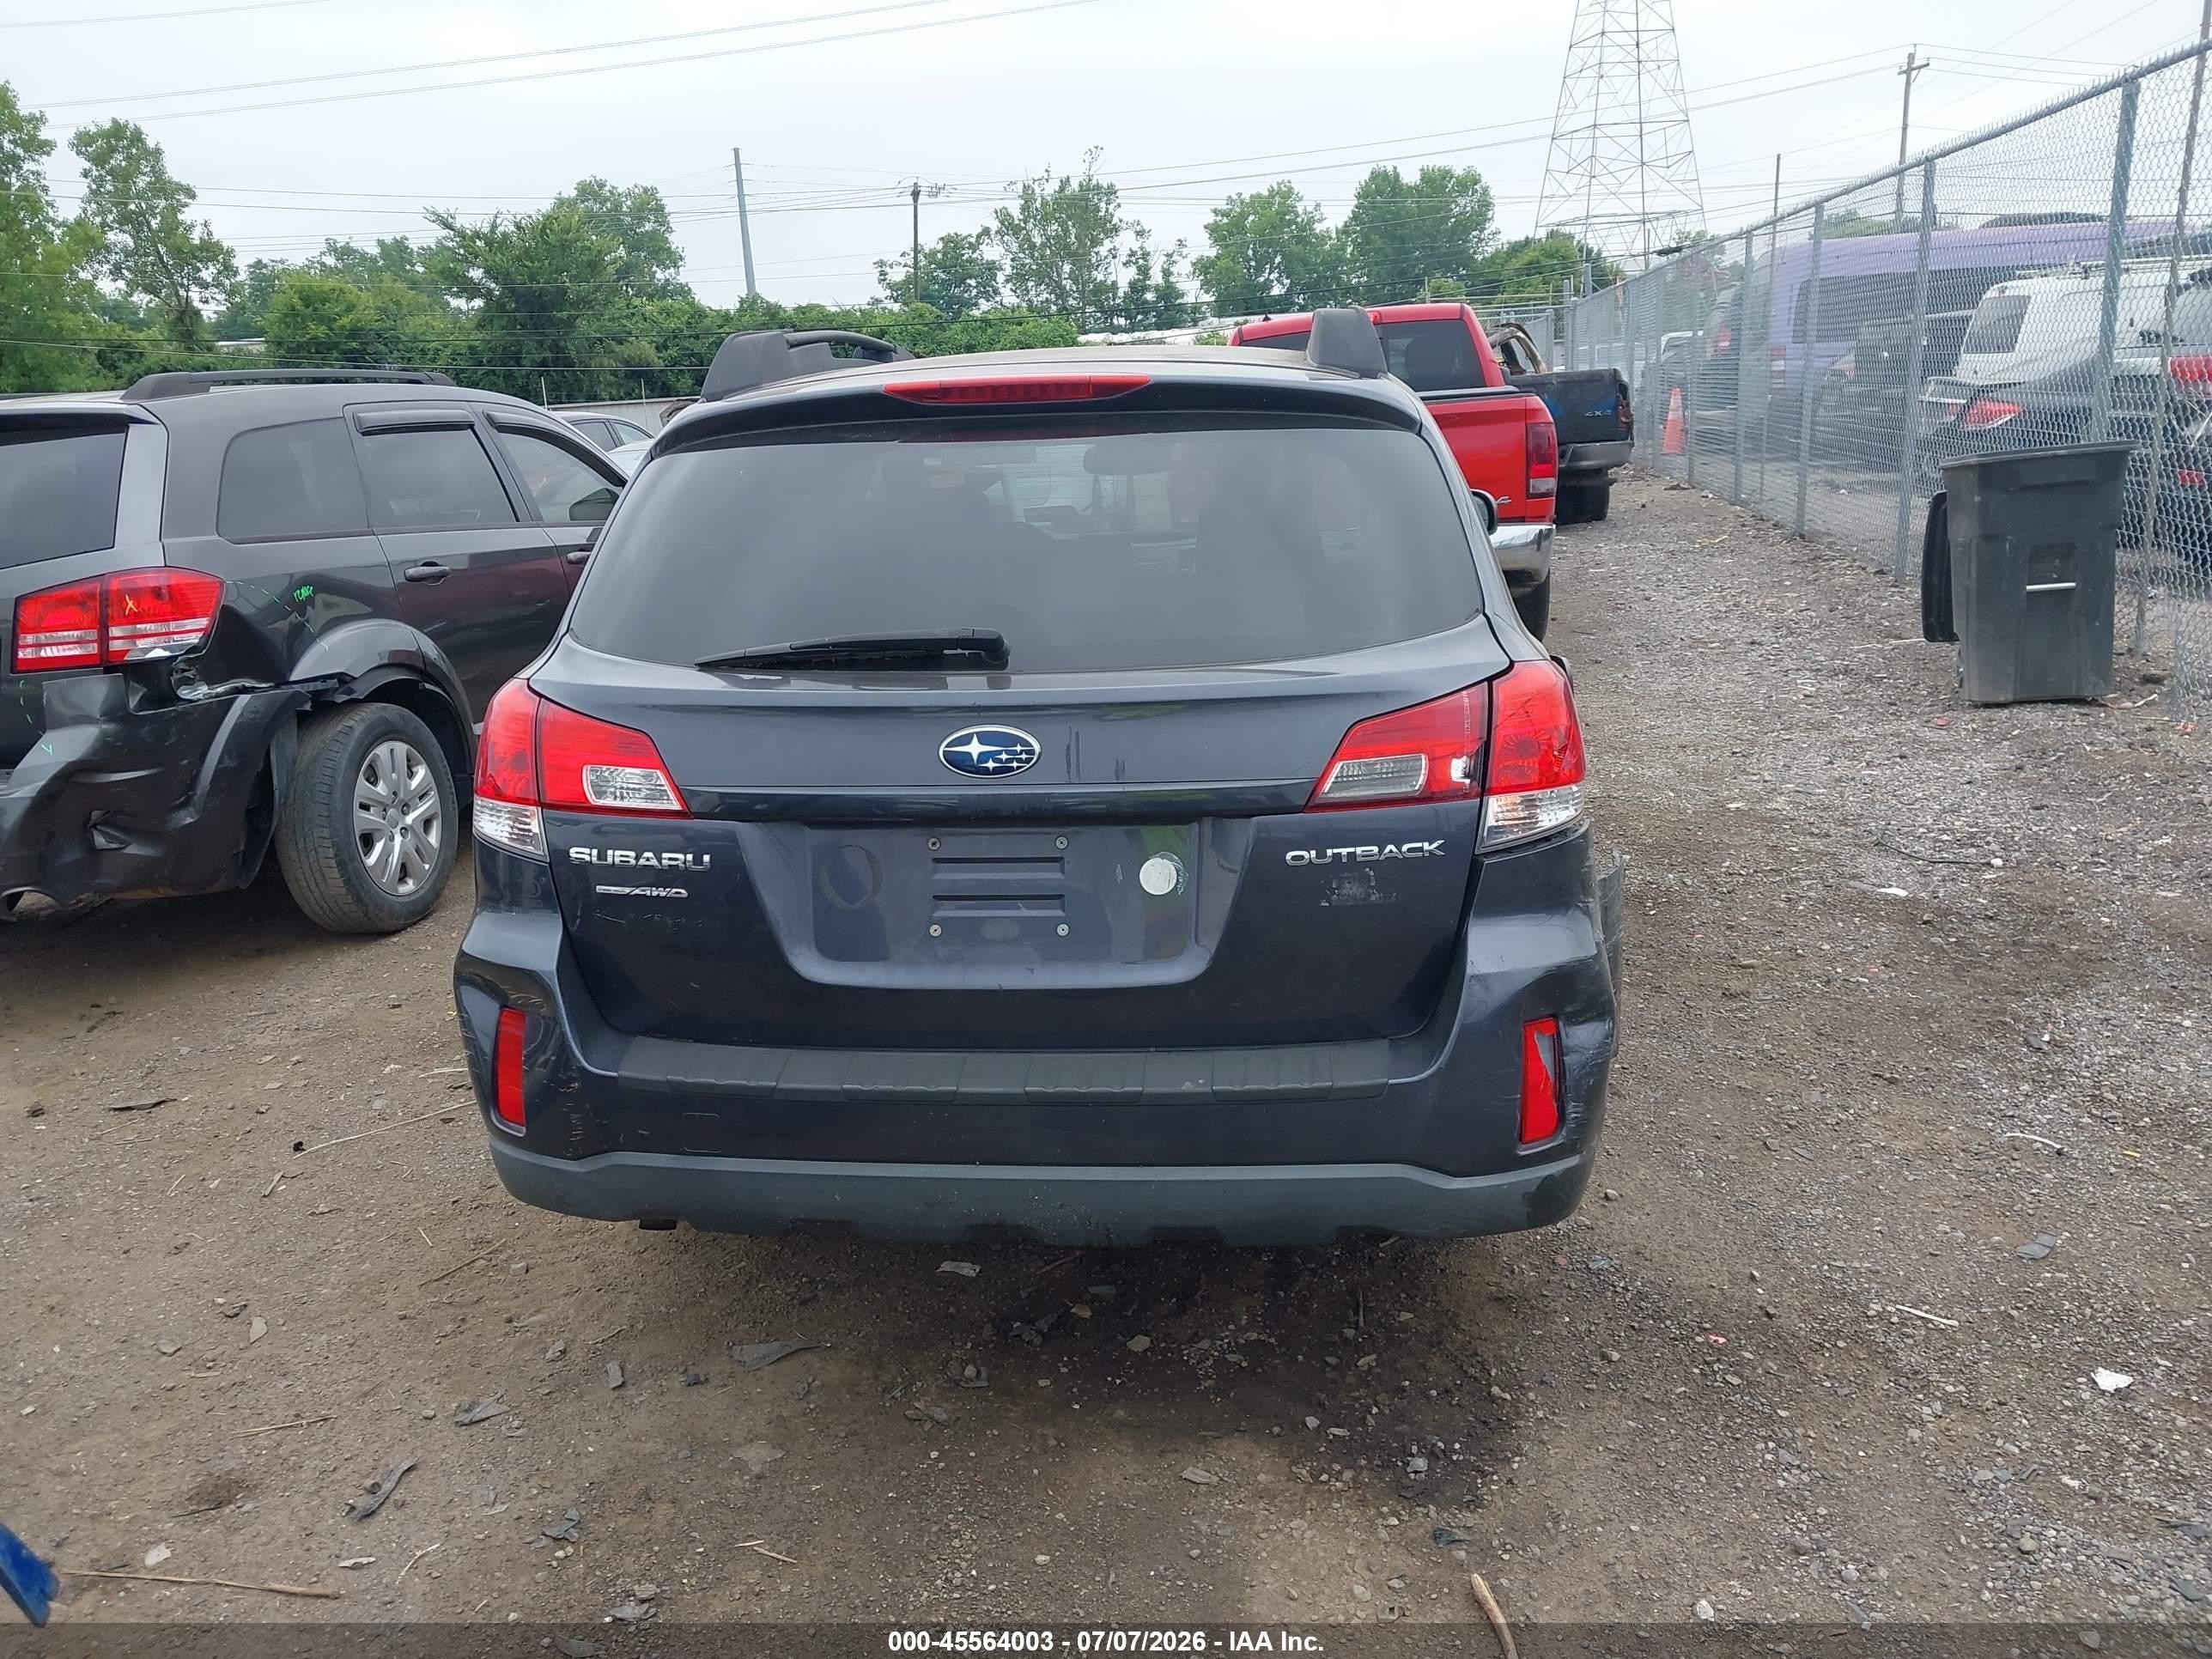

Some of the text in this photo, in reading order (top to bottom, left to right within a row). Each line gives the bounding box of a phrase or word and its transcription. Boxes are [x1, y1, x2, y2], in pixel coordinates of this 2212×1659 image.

[568, 846, 711, 872] SUBARU
[1285, 839, 1446, 866] OUTBACK
[628, 886, 689, 898] AWD
